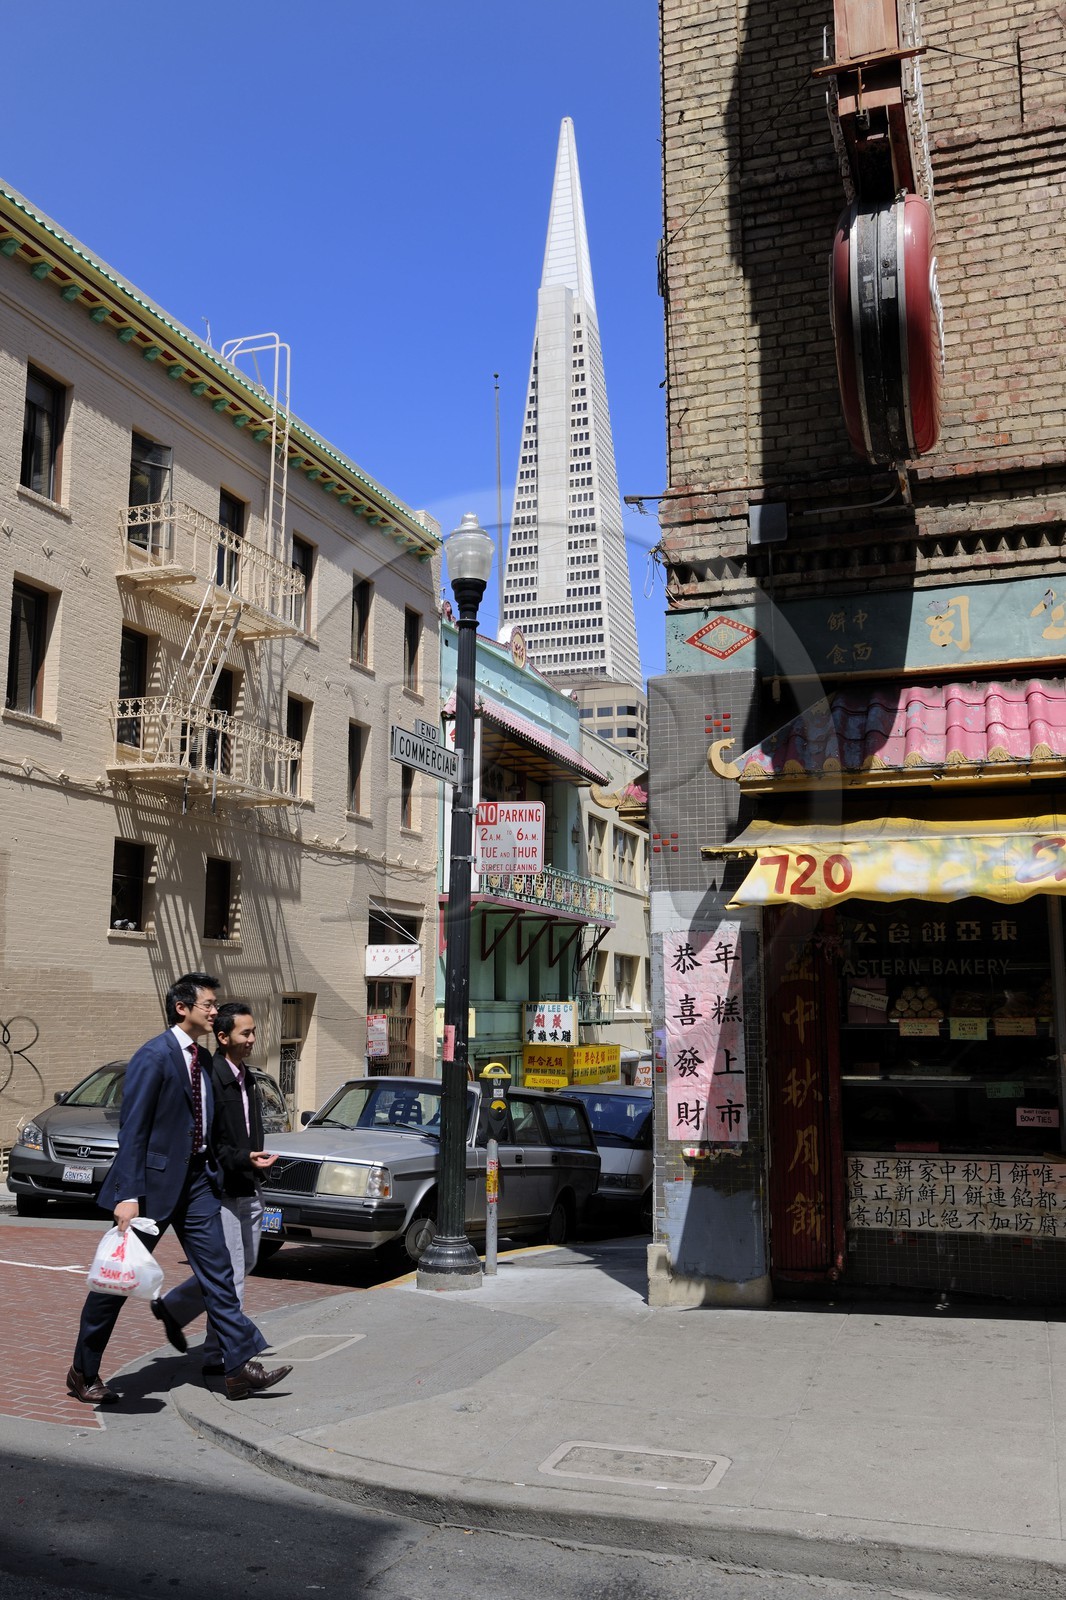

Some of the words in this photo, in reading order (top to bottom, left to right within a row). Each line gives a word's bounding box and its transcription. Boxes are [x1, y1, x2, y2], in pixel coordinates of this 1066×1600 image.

[693, 618, 721, 640] EASTERN
[723, 619, 754, 634] BAKERY
[724, 634, 754, 656] CALIFORNIA
[420, 722, 437, 740] END
[399, 735, 454, 777] COMMERCIAL
[478, 805, 497, 823] NO
[499, 808, 541, 823] PARKING
[480, 846, 498, 859] TUE
[512, 846, 538, 858] THUR
[481, 863, 504, 871] STREET
[505, 863, 538, 871] CLEANING
[759, 852, 853, 896] 720
[933, 958, 1010, 975] BAKERY
[526, 1004, 546, 1013] MOW
[547, 1004, 561, 1013] LEE
[670, 942, 705, 1132] 恭喜發財
[709, 941, 745, 1133] 年糕上市
[1020, 1114, 1035, 1122] BOW
[1036, 1115, 1053, 1124] TIES
[849, 1180, 1066, 1212] 眞正新鮮月餅連餡都
[851, 1204, 1066, 1236] 煮的因此絕不加防腐
[100, 1266, 122, 1281] THANK
